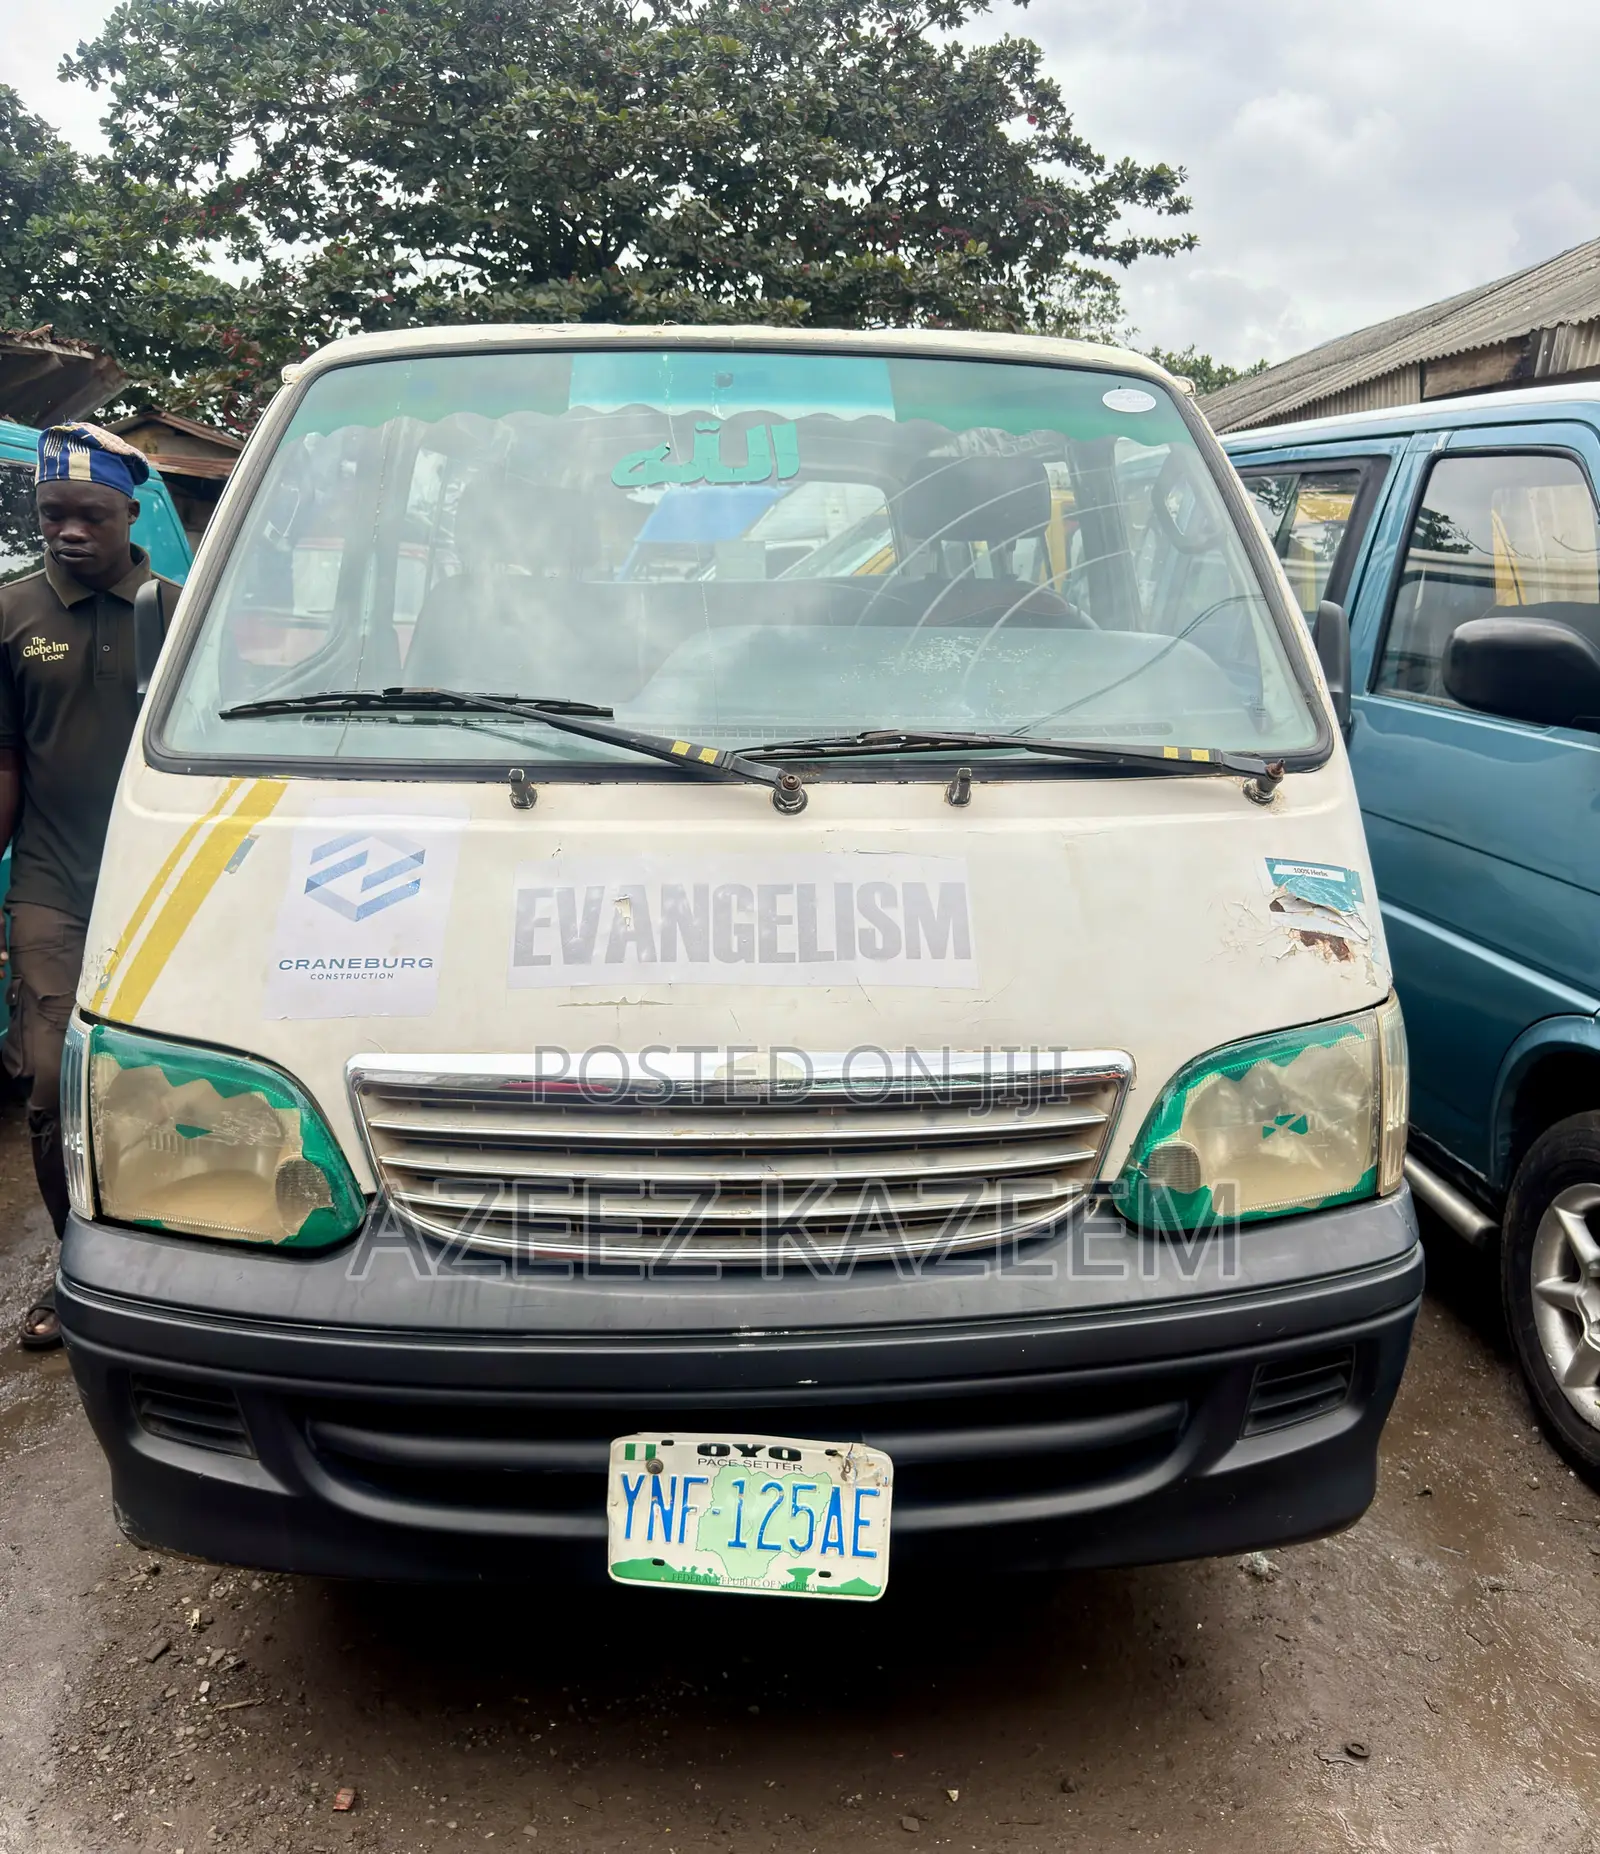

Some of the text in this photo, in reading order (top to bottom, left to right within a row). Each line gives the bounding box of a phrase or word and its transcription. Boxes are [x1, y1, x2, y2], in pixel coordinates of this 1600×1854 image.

[611, 420, 800, 487] الله
[32, 636, 46, 645] The
[23, 642, 69, 657] Globe Inn
[42, 653, 64, 662] Looe
[1293, 867, 1328, 877] 100% Herbs
[513, 882, 971, 967] EVANGELISM
[278, 957, 433, 970] CRANEBURG
[310, 972, 394, 980] CONSTRUCTION
[697, 1442, 802, 1462] OYO
[697, 1457, 804, 1473] PACE SETTER
[762, 1579, 776, 1588] OF
